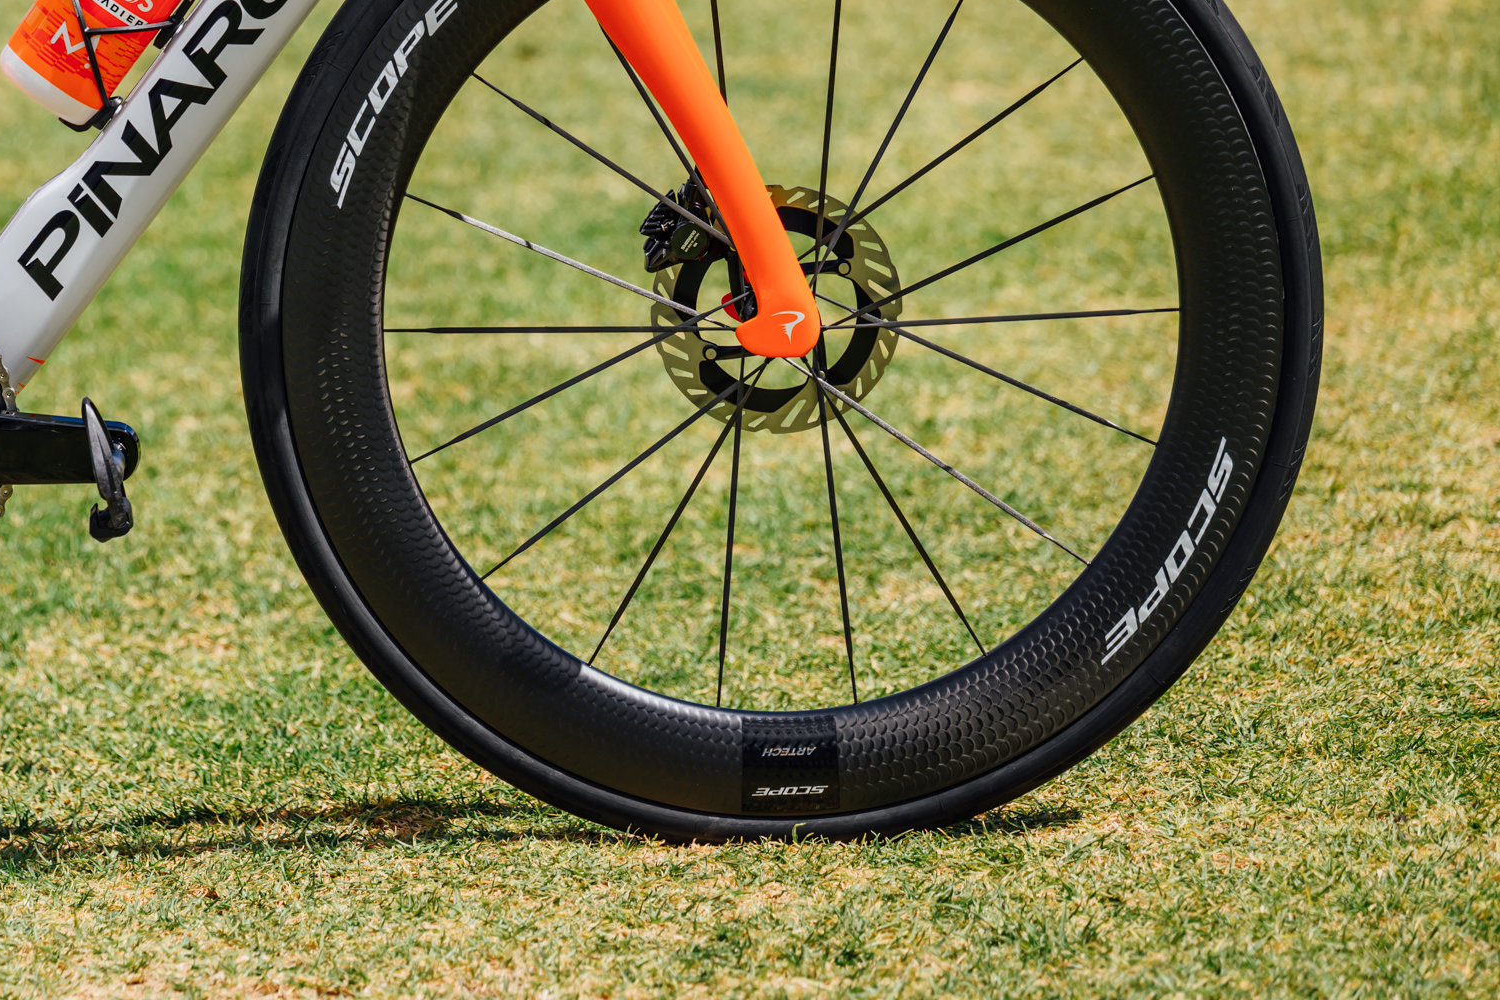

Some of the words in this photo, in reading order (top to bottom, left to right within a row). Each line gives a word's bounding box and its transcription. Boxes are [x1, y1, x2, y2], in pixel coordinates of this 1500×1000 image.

[1101, 436, 1233, 666] SCOPE
[761, 746, 817, 757] ARTECH
[751, 784, 829, 797] SCOPE
